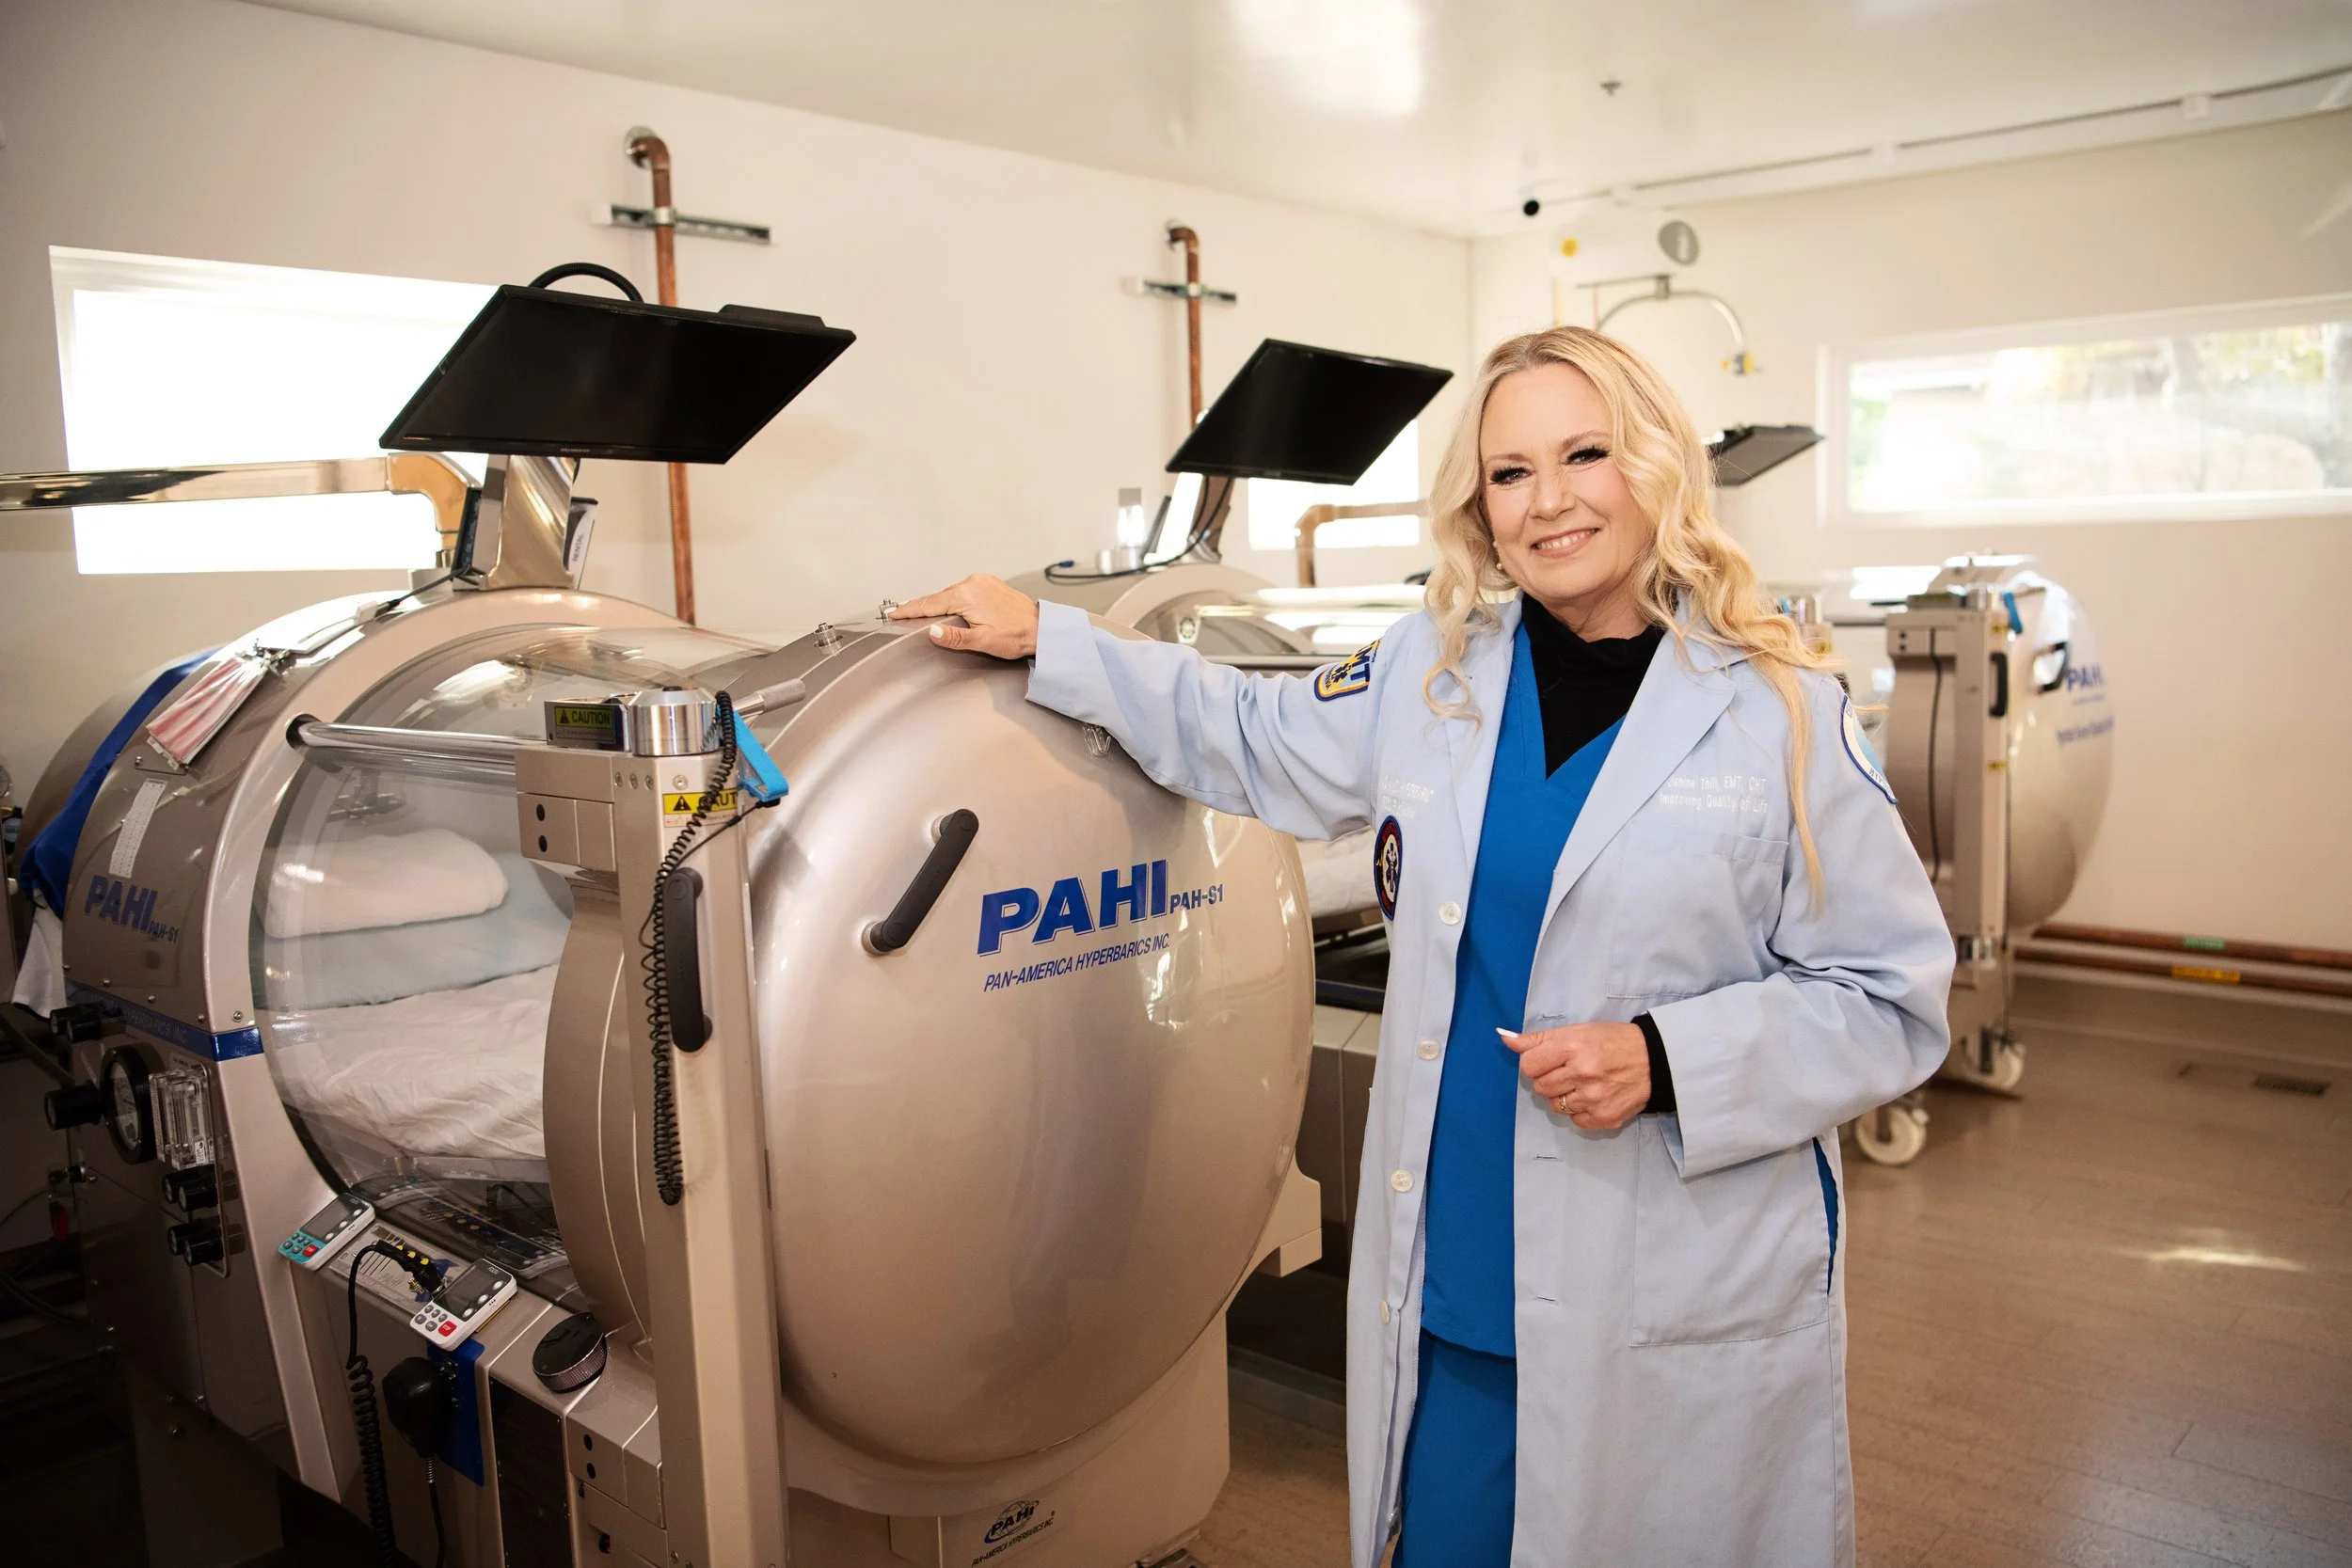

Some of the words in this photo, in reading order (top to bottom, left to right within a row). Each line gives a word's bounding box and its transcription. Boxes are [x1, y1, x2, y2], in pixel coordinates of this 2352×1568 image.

[571, 710, 611, 725] CAUTION
[1706, 794, 1737, 812] Quality
[1740, 796, 1750, 811] of
[83, 874, 159, 933] PAHI
[148, 921, 179, 943] PAH-S1
[977, 860, 1168, 957] PAHI
[1169, 883, 1224, 914] PAH-S1
[983, 955, 1073, 992] PAN-AMERICA
[1075, 938, 1151, 971] HYPERBARICS
[1152, 933, 1170, 954] INC.
[990, 1505, 1035, 1537] PAHI
